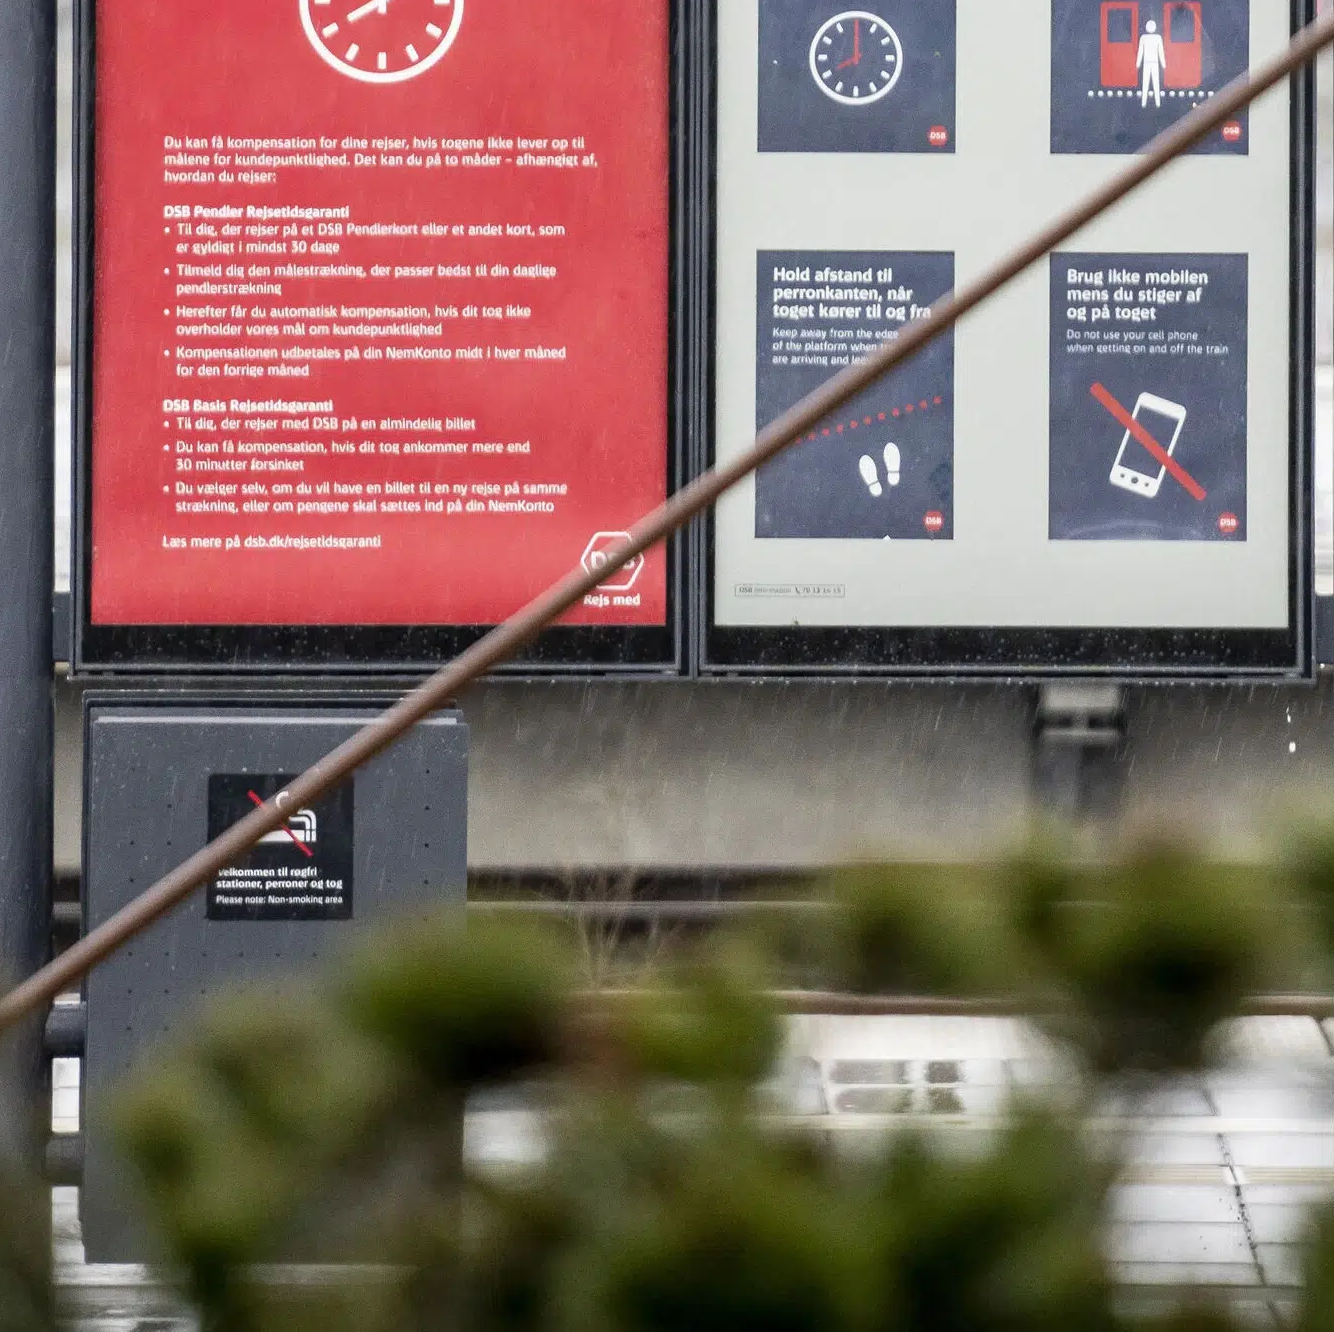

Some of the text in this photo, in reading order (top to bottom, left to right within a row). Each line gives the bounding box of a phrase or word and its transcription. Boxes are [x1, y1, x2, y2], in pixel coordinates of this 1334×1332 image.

[929, 130, 947, 140] DSB
[163, 135, 183, 149] Du
[185, 135, 209, 149] kan
[211, 135, 224, 149] få
[319, 135, 338, 149] for
[340, 136, 369, 150] dine
[412, 136, 438, 150] hvis
[441, 138, 485, 151] togene
[487, 136, 514, 149] ikke
[517, 136, 549, 150] lever
[551, 138, 569, 151] op
[571, 136, 585, 149] til
[163, 151, 211, 166] målene
[213, 152, 232, 166] for
[353, 152, 377, 166] Det
[380, 153, 404, 167] kan
[405, 153, 423, 167] du
[425, 152, 442, 169] på
[444, 154, 459, 166] to
[461, 152, 503, 167] måder
[515, 153, 579, 168] afhængigt
[163, 169, 215, 183] hvordan
[218, 169, 235, 183] du
[163, 205, 191, 219] DSB
[193, 204, 244, 219] Pendler
[773, 266, 893, 283] Hold afstand til
[1066, 268, 1209, 287] Brug ikke mobilen
[887, 285, 914, 302] når
[1067, 286, 1202, 305] mens du stiger af
[772, 304, 815, 320] toget
[818, 302, 862, 319] kører
[865, 303, 882, 319] til
[885, 306, 906, 322] og
[1066, 304, 1157, 323] og på toget
[162, 398, 190, 413] DSB
[193, 399, 227, 413] Basis
[176, 457, 304, 471] 30 minutter forsinket
[162, 535, 187, 549] Læs
[190, 537, 222, 549] mere
[225, 534, 241, 550] på
[583, 593, 641, 608] Rejs med
[277, 866, 289, 877] til
[289, 866, 318, 879] røgfri
[265, 880, 309, 890] perroner
[310, 879, 324, 890] og
[325, 879, 343, 890] tog
[216, 894, 243, 905] Please
[324, 896, 343, 904] area
